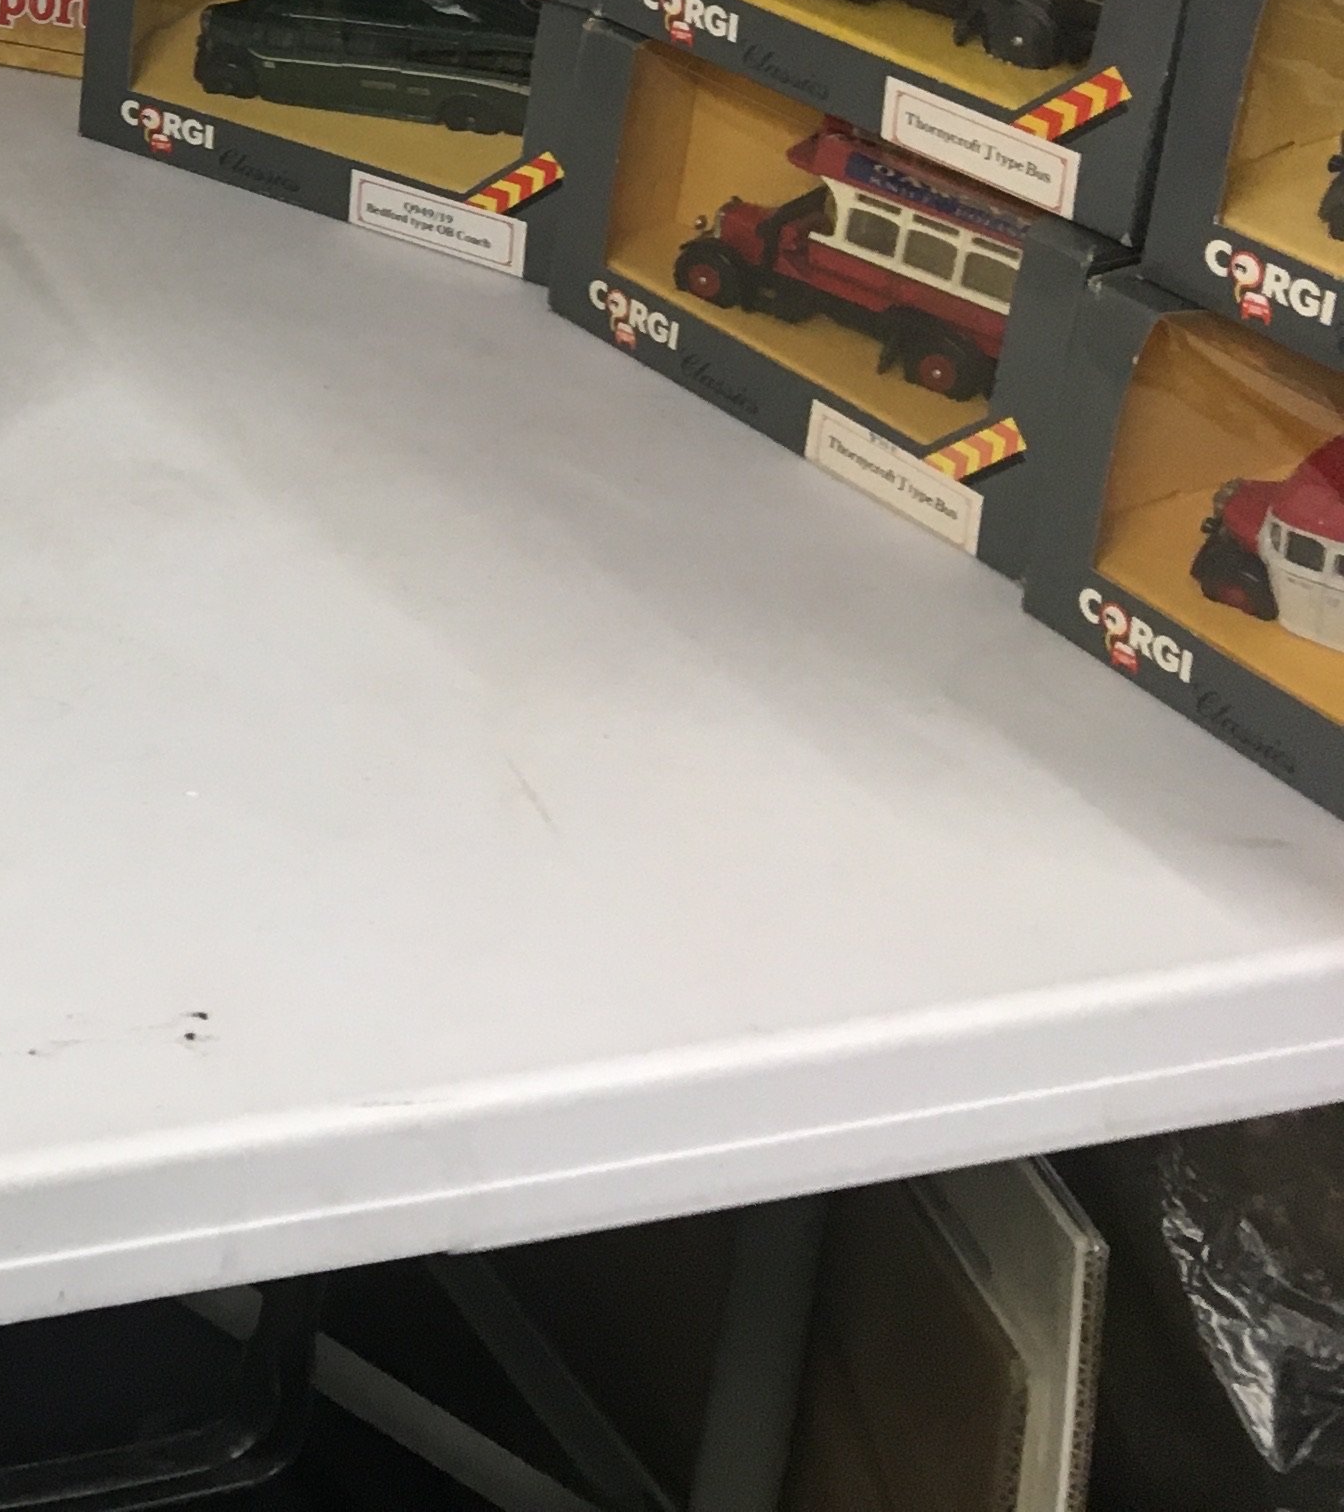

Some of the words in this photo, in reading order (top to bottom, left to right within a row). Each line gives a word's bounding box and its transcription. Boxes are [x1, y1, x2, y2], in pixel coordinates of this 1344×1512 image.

[120, 100, 215, 150] CORGI
[905, 112, 981, 154] Thornycroft
[1025, 161, 1052, 184] Bus
[365, 202, 409, 224] Bedford
[455, 229, 492, 249] Coach
[588, 280, 680, 351] CORGI
[1204, 239, 1338, 327] CORGI
[1078, 587, 1195, 684] CORGI
